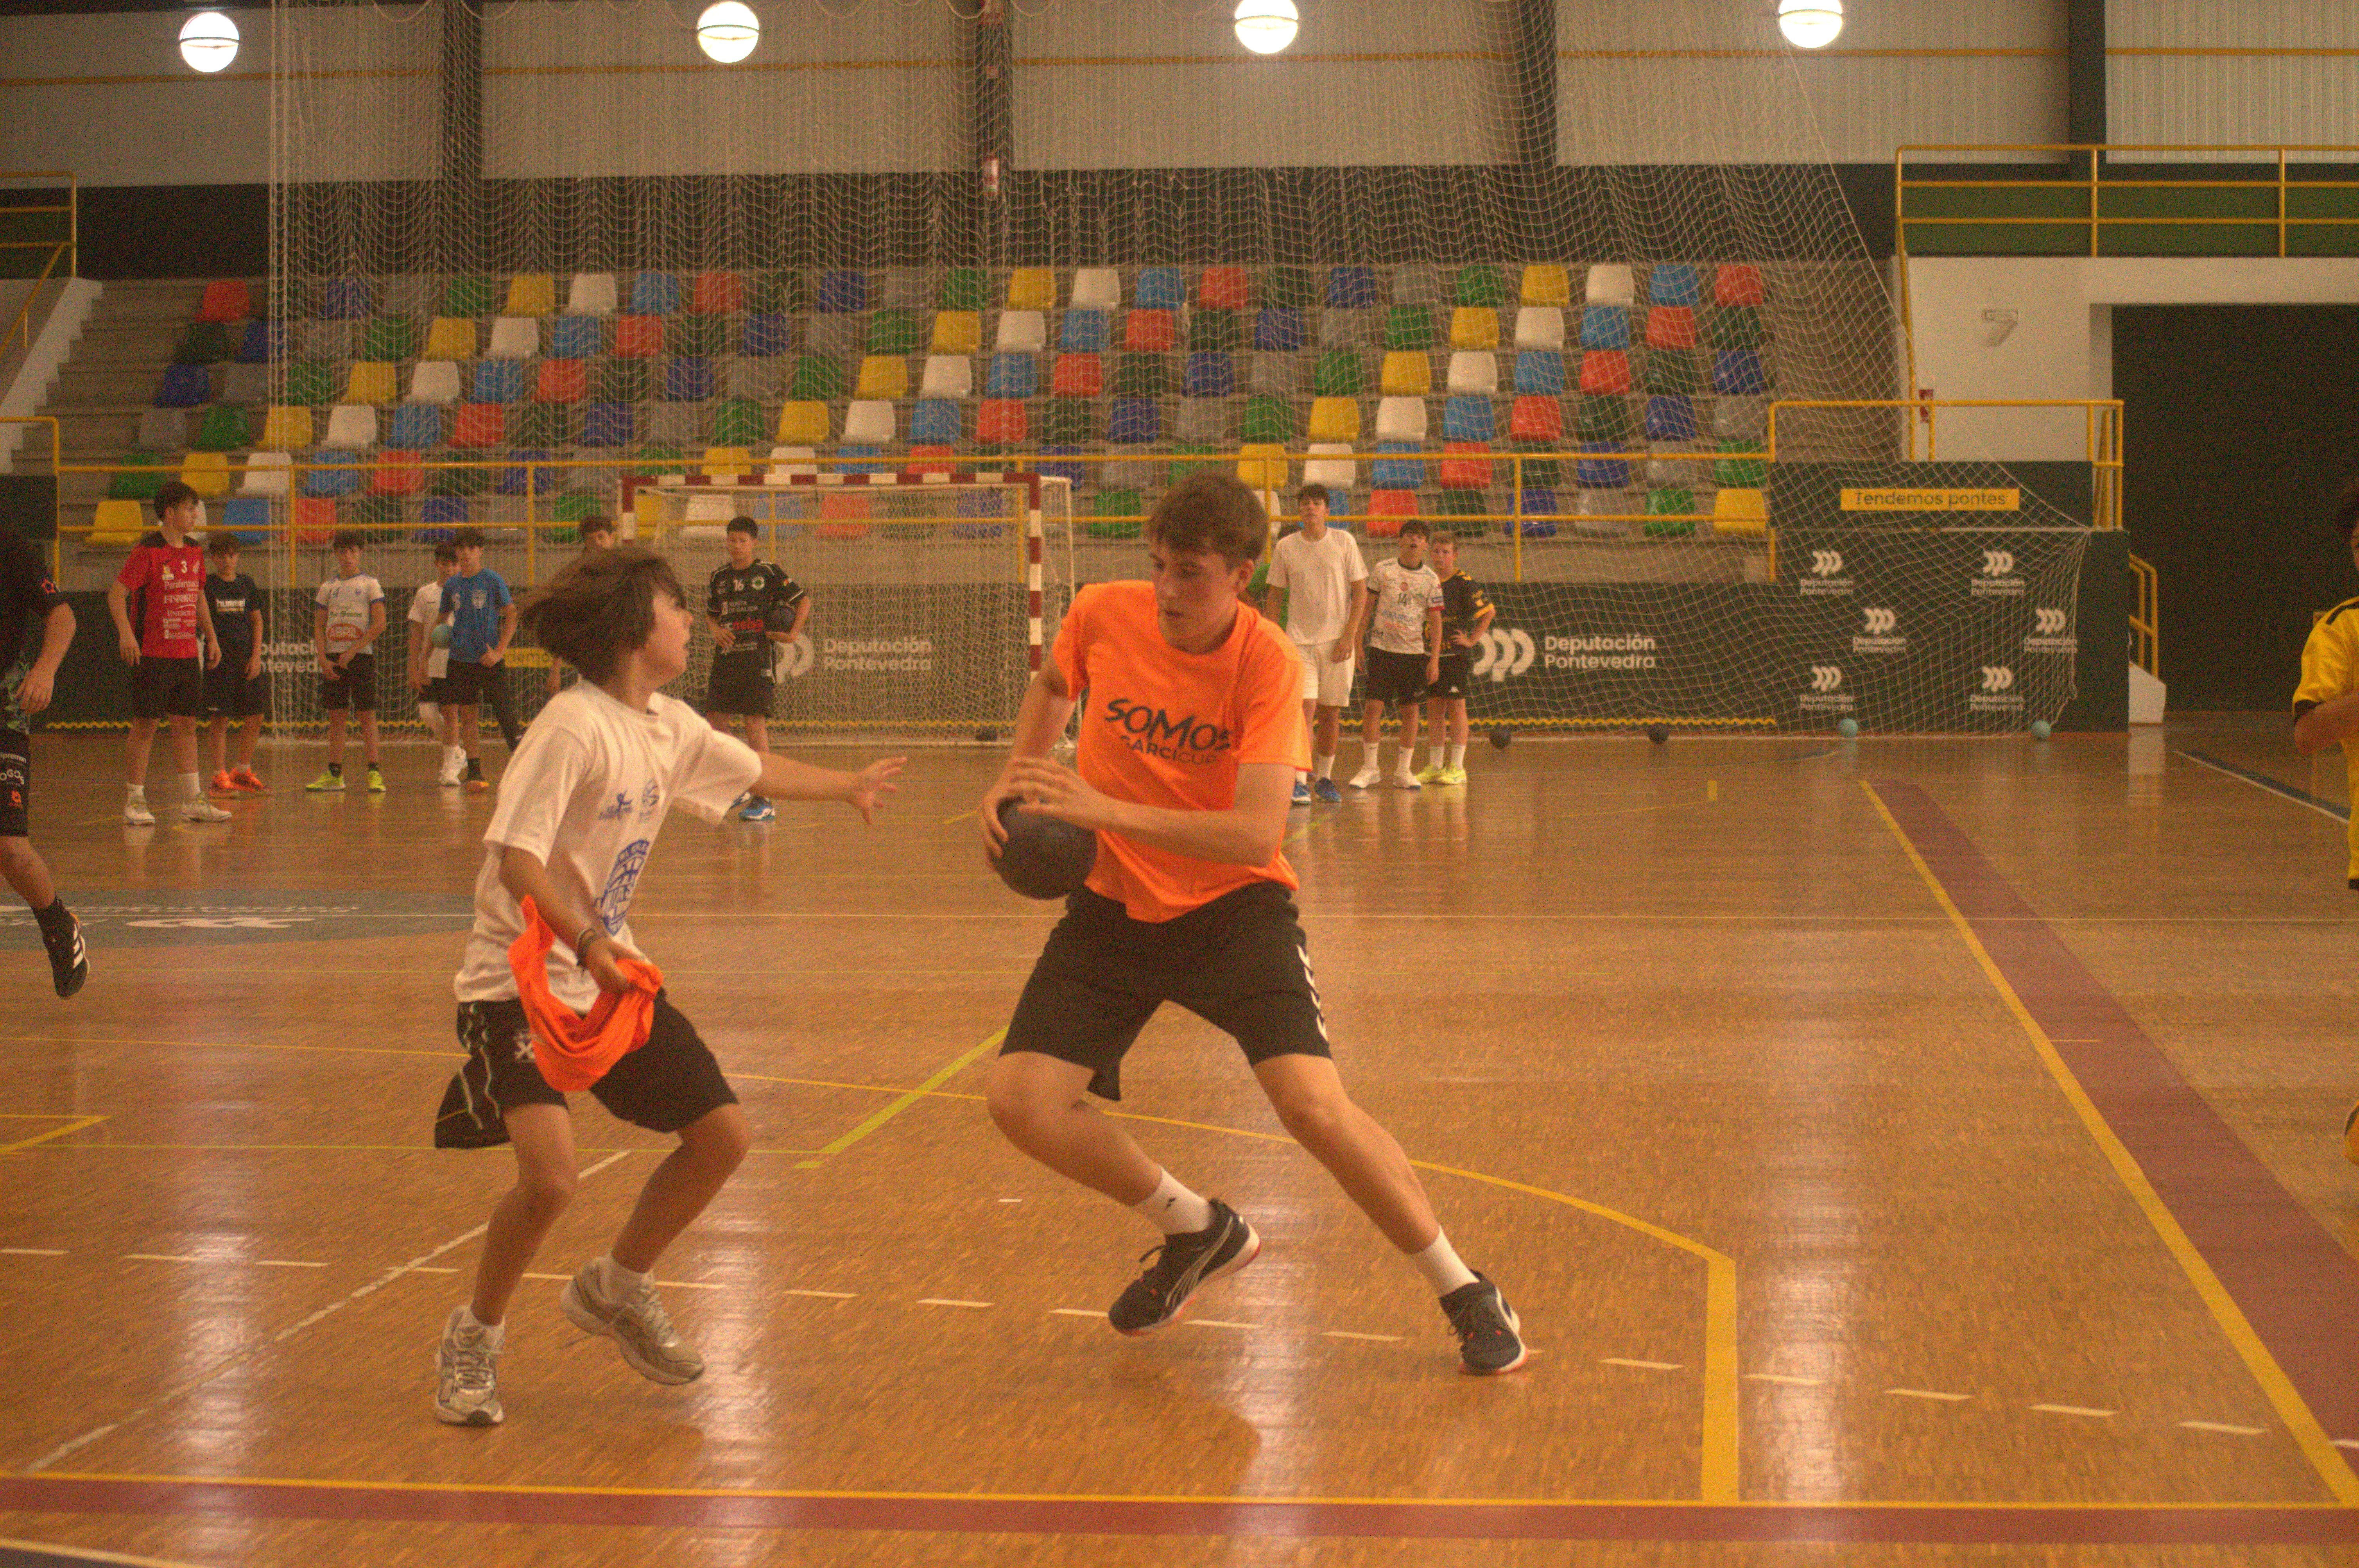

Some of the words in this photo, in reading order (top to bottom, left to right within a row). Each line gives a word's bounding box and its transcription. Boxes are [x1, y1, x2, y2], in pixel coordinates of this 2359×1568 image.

[1855, 491, 1943, 506] Tendemos
[1949, 492, 2006, 510] pontes
[181, 560, 187, 573] 3
[733, 579, 744, 591] 16
[825, 637, 933, 656] Deputación
[1545, 634, 1655, 654] Deputación
[825, 656, 932, 671] Pontevedra
[1545, 653, 1655, 669] Pontevedra
[1105, 698, 1230, 752] SOMOS
